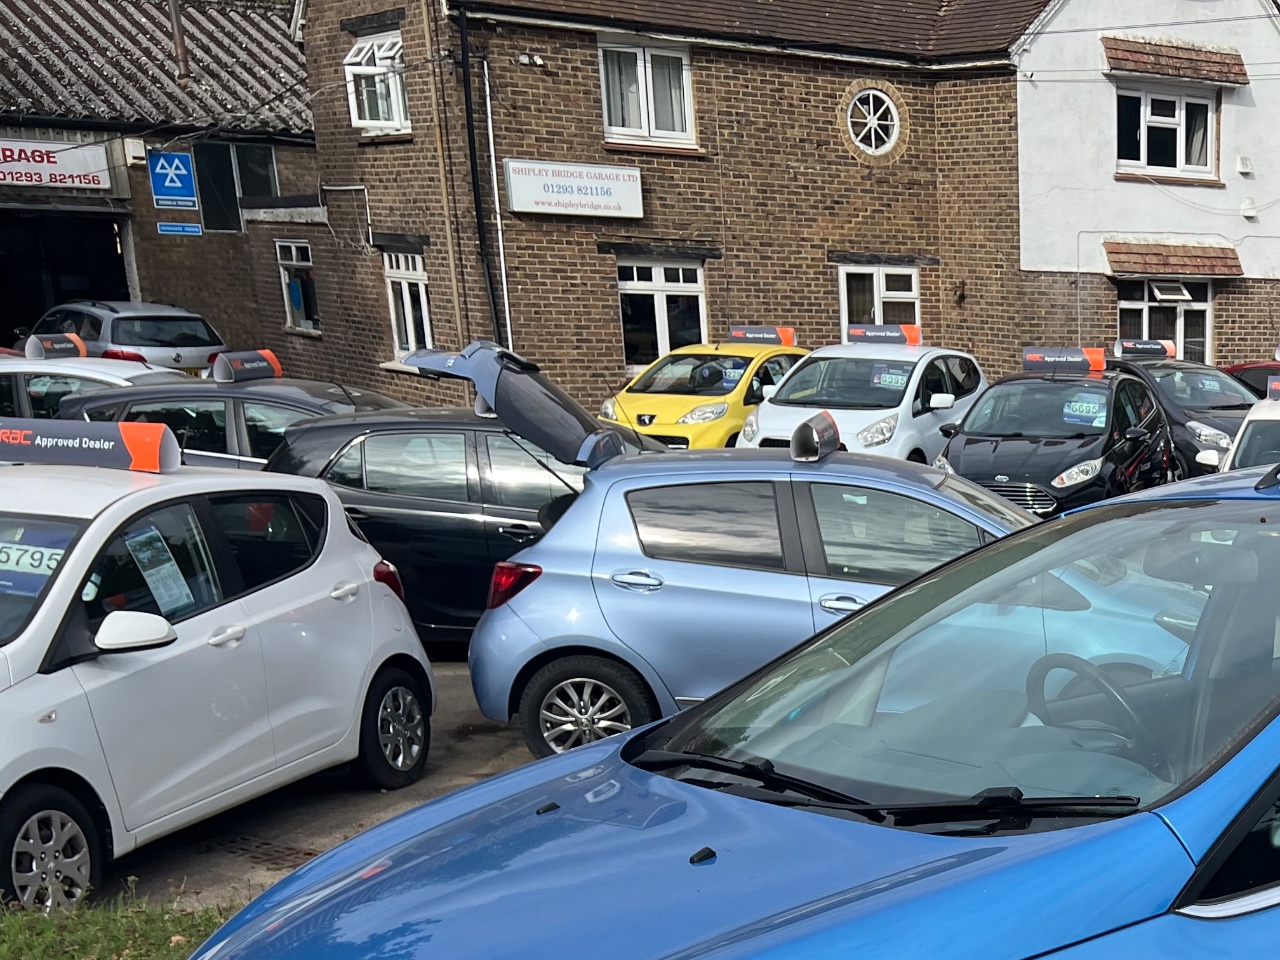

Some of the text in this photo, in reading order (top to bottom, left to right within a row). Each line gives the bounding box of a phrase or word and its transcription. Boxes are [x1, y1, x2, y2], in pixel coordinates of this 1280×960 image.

[0, 170, 101, 185] 01293 821156
[512, 167, 638, 183] SHIPLEY BRIDGE GARAGE LTD
[543, 183, 612, 197] 01293 821156
[534, 199, 622, 211] www.shipleybridge.co.uk
[0, 429, 115, 450] RAC Approved Dealer
